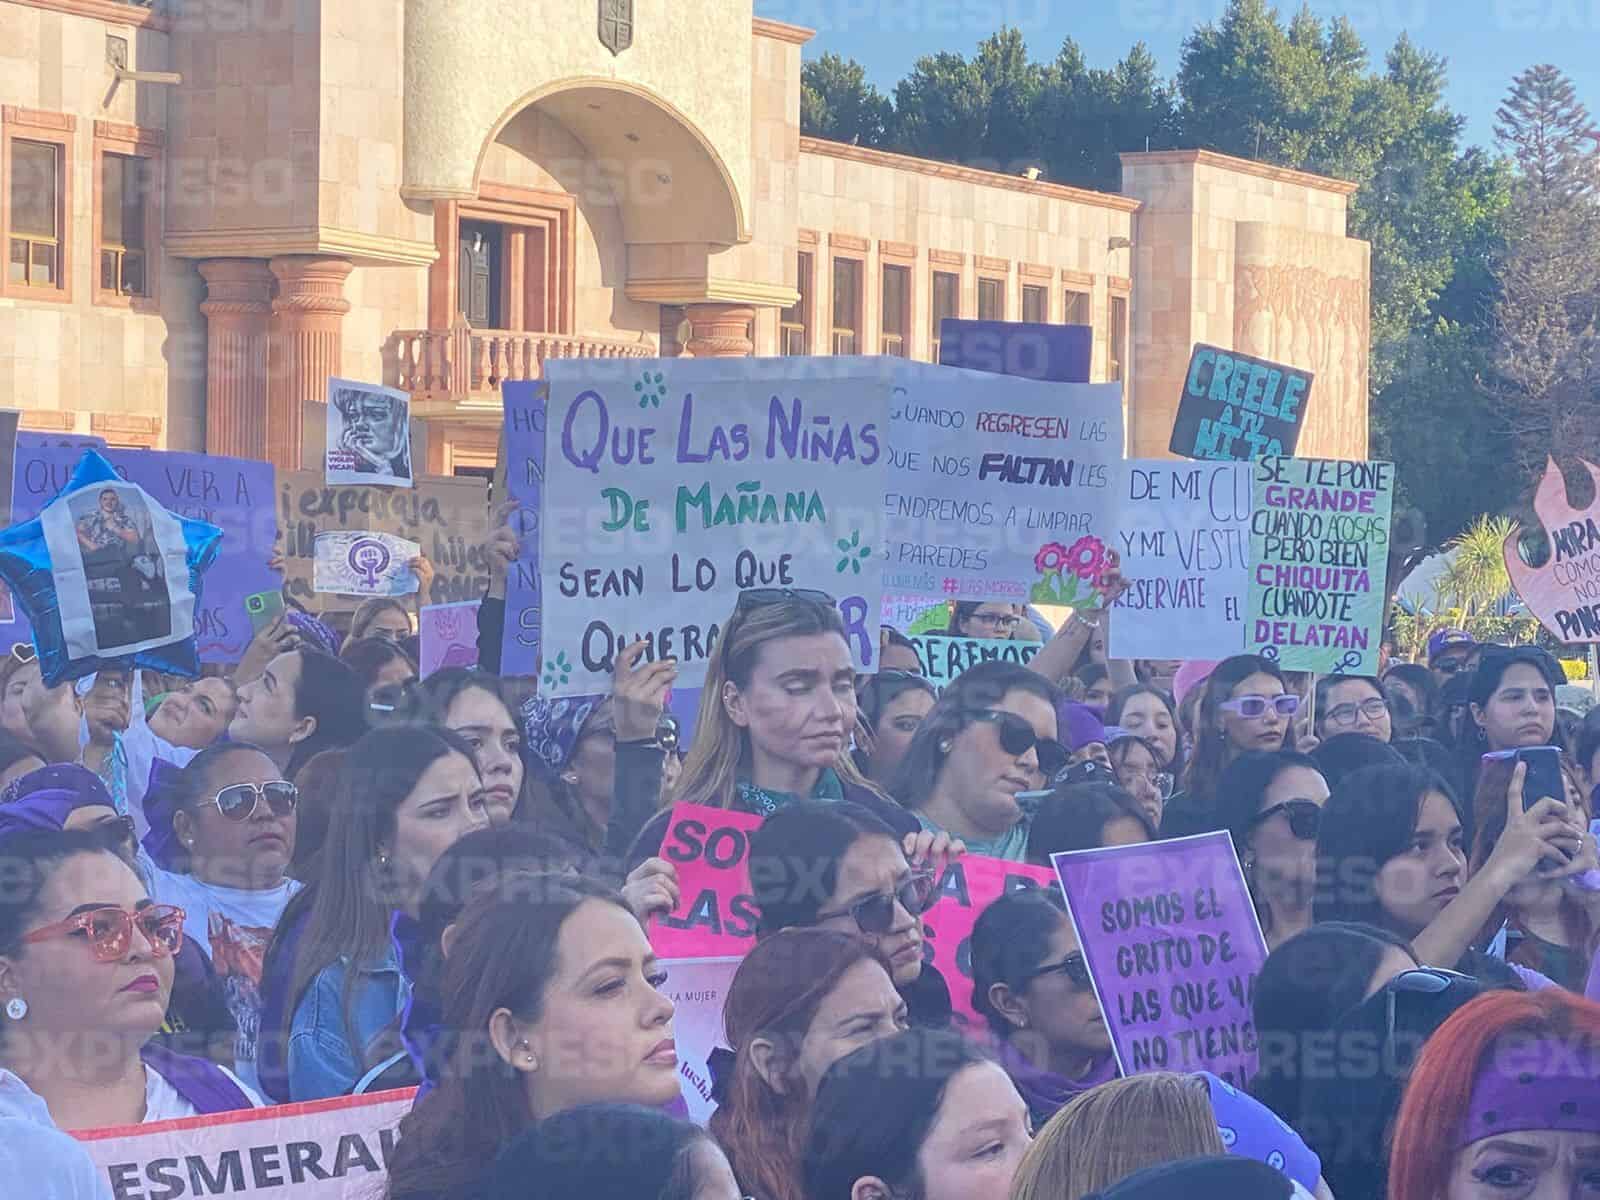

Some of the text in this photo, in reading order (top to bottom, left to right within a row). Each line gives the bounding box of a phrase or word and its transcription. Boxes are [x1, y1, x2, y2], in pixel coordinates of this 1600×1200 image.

[1187, 350, 1306, 423] CREELE
[561, 390, 881, 474] QUE LAS NIÑAS
[976, 411, 1069, 440] REGRESEN
[1079, 421, 1107, 442] LAS
[165, 466, 220, 501] VER
[235, 471, 251, 506] A
[932, 456, 970, 477] NOS
[979, 453, 1073, 487] FALTAN
[1078, 464, 1107, 488] LES
[1130, 469, 1161, 500] DE
[1171, 470, 1201, 500] MI
[1256, 455, 1292, 483] SE
[600, 487, 651, 531] DE
[675, 481, 826, 533] MAÑANA
[884, 494, 1093, 534] ENDREMOS A LIMPIAR
[1265, 484, 1376, 513] GRANDE
[1119, 530, 1135, 557] Y
[1141, 531, 1165, 557] MI
[1251, 509, 1387, 545] CUANDO ACOSAS
[898, 542, 988, 571] PAREDES
[1263, 536, 1368, 568] PERO BIEN
[559, 562, 644, 598] SEAN
[672, 553, 717, 592] LO
[735, 550, 794, 588] QUE
[1255, 563, 1370, 593] CHIQUITA
[1225, 596, 1241, 622] EL
[1254, 619, 1369, 650] DELATAN
[666, 820, 751, 871] SO
[1101, 887, 1225, 934] SOMOS EL
[1116, 931, 1236, 978] GRITO DE
[685, 990, 717, 1002] MUJER
[1118, 988, 1162, 1026] LAS
[1170, 979, 1225, 1021] QUE
[1132, 1035, 1169, 1070] NO
